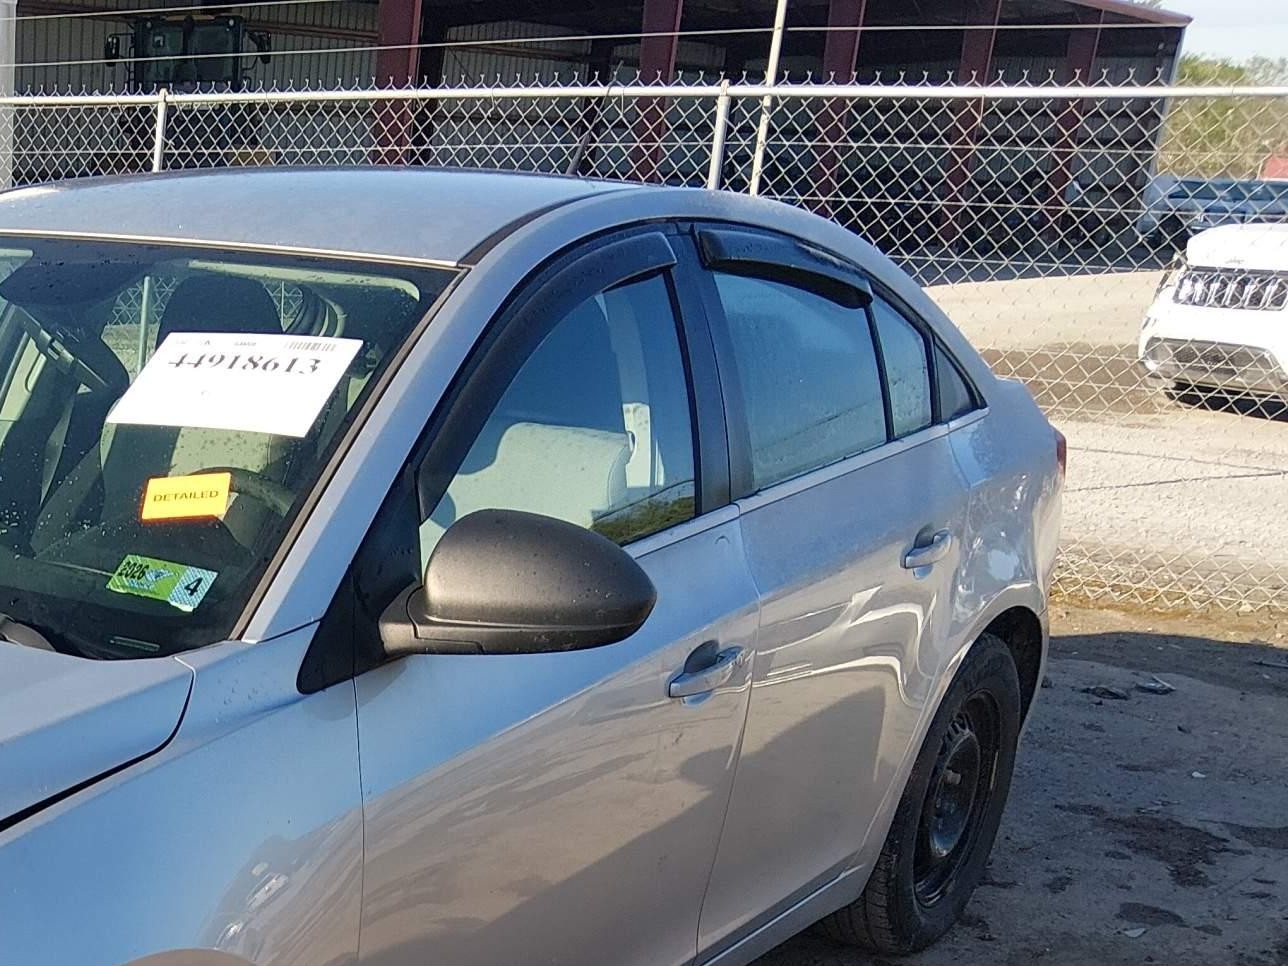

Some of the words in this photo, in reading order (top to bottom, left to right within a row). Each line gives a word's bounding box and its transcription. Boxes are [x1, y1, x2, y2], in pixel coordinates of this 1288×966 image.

[168, 353, 321, 375] 44918613
[153, 490, 219, 502] DETAILED
[118, 561, 150, 581] 2026
[184, 577, 203, 596] 4
